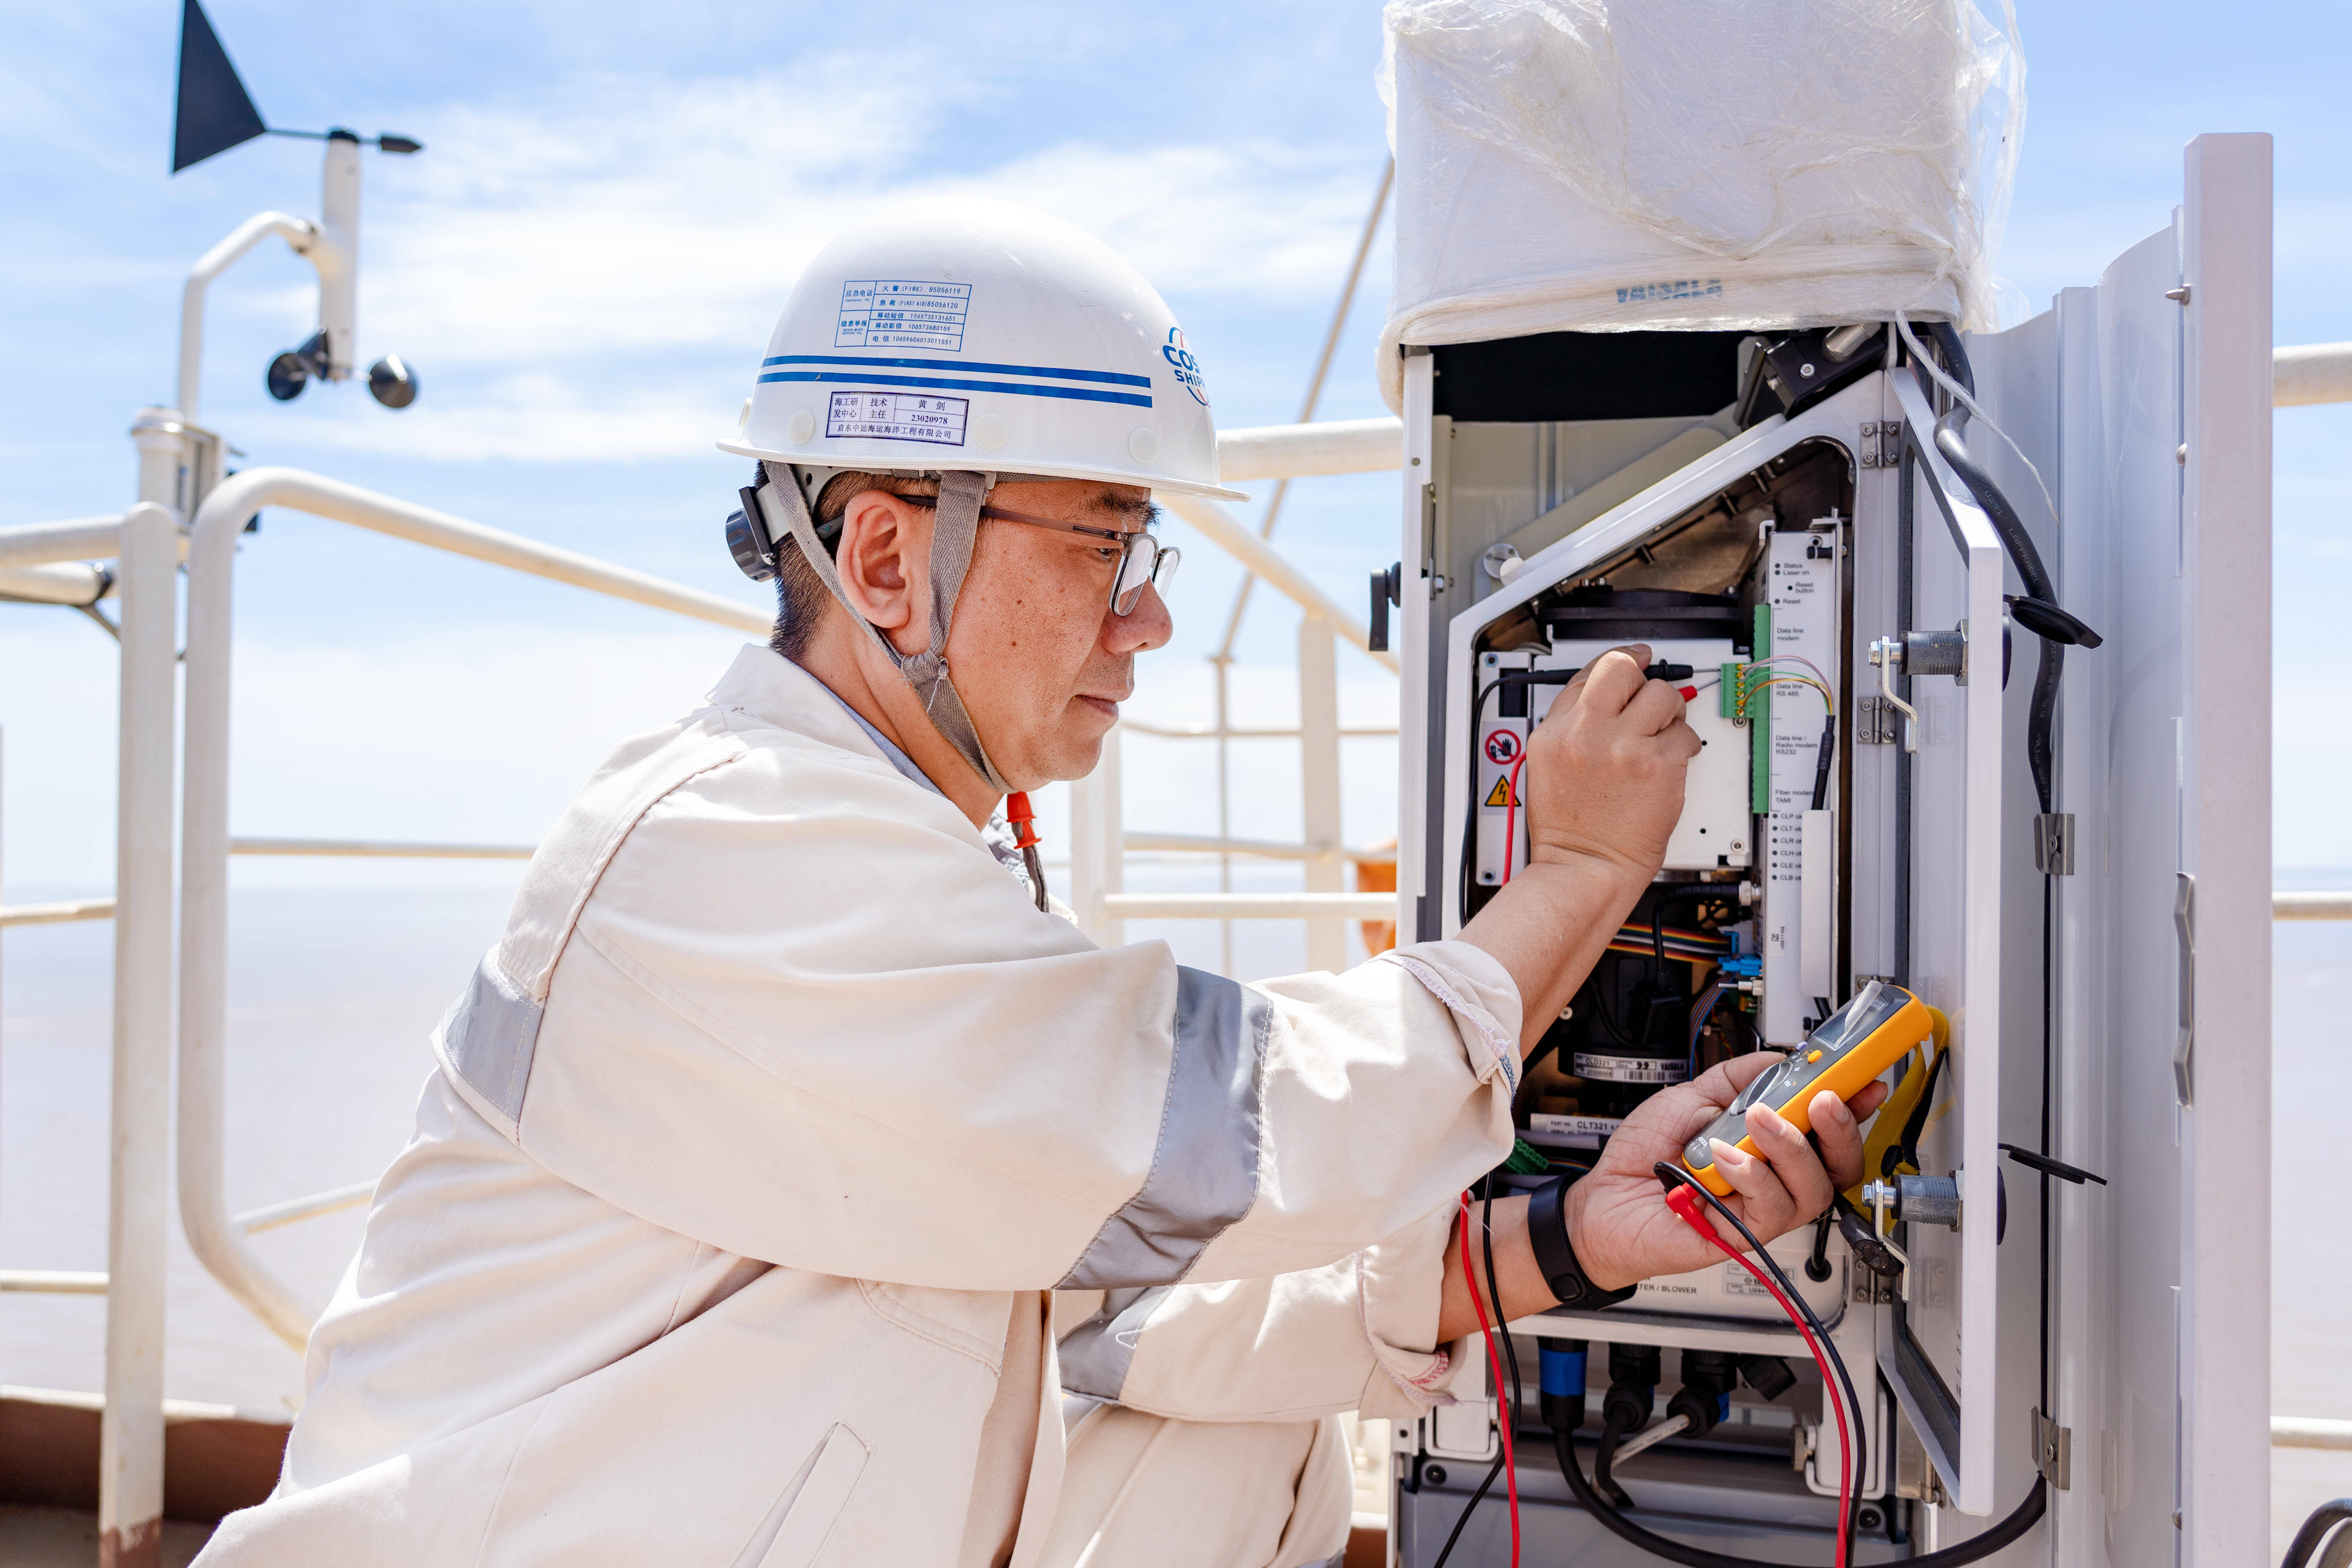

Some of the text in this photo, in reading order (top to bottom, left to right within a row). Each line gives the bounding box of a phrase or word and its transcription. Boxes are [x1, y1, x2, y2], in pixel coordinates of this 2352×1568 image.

[893, 336, 952, 345] 10659606013011551
[835, 397, 859, 407] 海工研
[870, 397, 888, 407] 技术
[833, 409, 857, 419] 发中心
[869, 410, 886, 419] 主任
[911, 414, 948, 424] 23020978
[837, 424, 952, 439] 启东中远海运海洋工程有限公司
[2008, 528, 2038, 585] LAPPKABEL
[1577, 1120, 1607, 1130] CLT321
[1661, 1285, 1697, 1294] BLOWER
